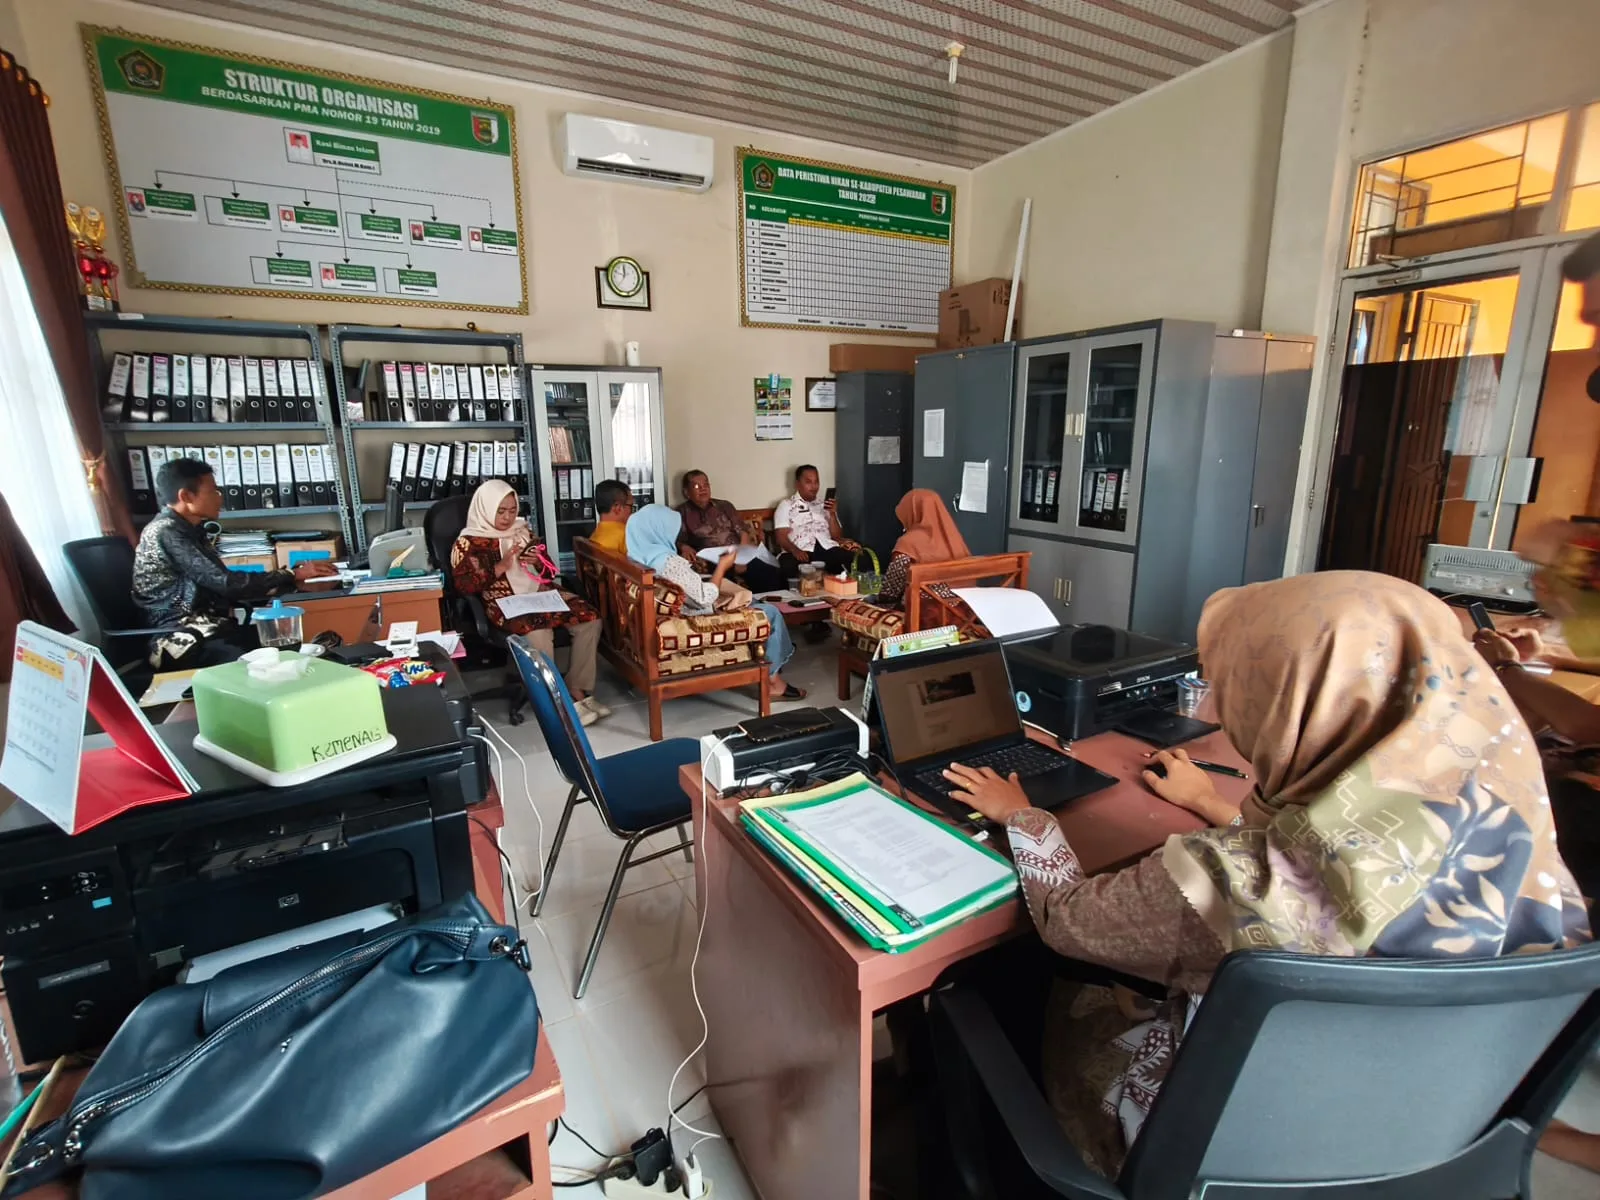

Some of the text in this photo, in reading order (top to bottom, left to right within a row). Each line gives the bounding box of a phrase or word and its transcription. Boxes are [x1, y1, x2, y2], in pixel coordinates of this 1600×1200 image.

[201, 86, 441, 136] BERDASARKAN PMA NOMOR 19 TAHUN 2019
[223, 68, 419, 121] STRUKTUR ORGANISASI
[777, 167, 926, 200] DATA PERISTIWA NIKAH SE-KABUPATEN PESAWARAN
[838, 189, 858, 202] TAHUN
